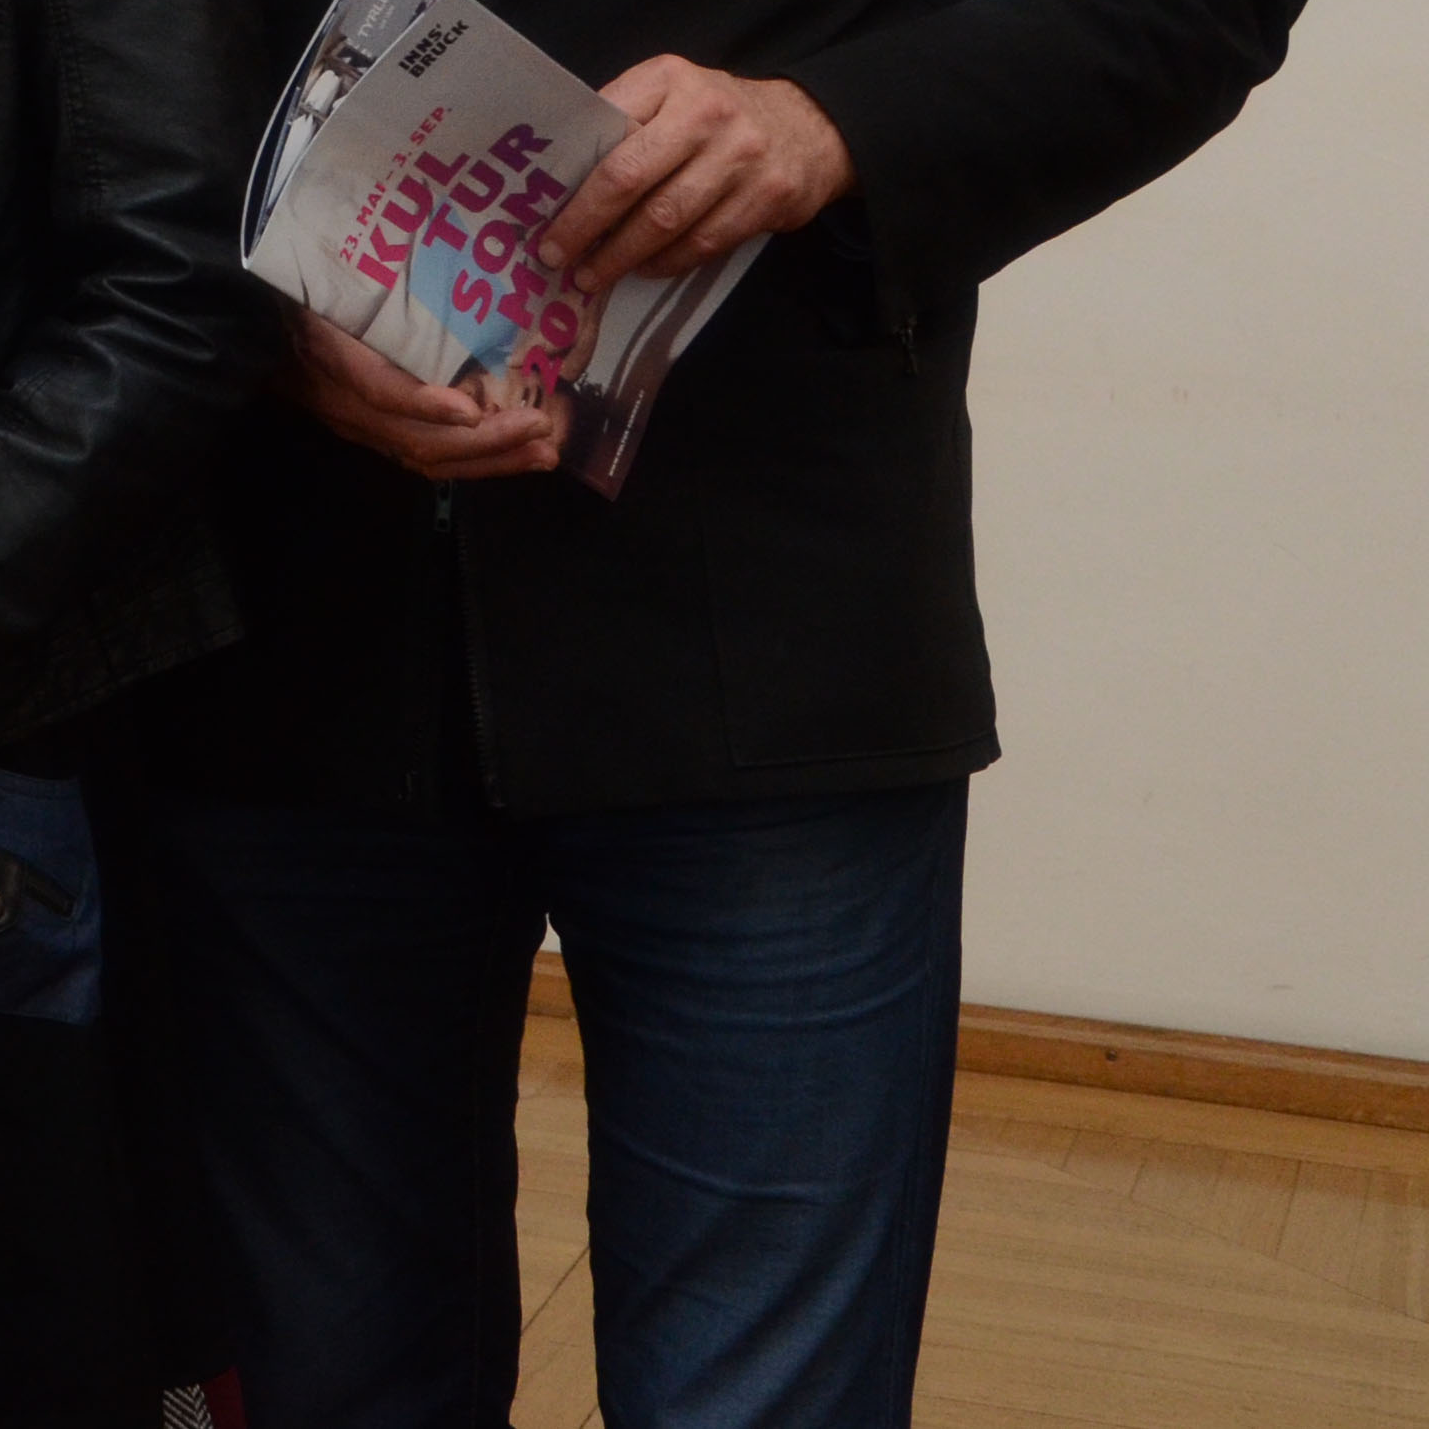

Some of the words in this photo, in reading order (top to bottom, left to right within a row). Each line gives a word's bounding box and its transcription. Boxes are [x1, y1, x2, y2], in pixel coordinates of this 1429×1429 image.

[408, 19, 469, 78] BRUCK
[340, 231, 362, 263] 23.
[356, 181, 387, 227] MAI
[409, 106, 453, 146] SEP.
[356, 150, 471, 290] KUL
[421, 124, 554, 253] TUR
[451, 167, 568, 325] SOM
